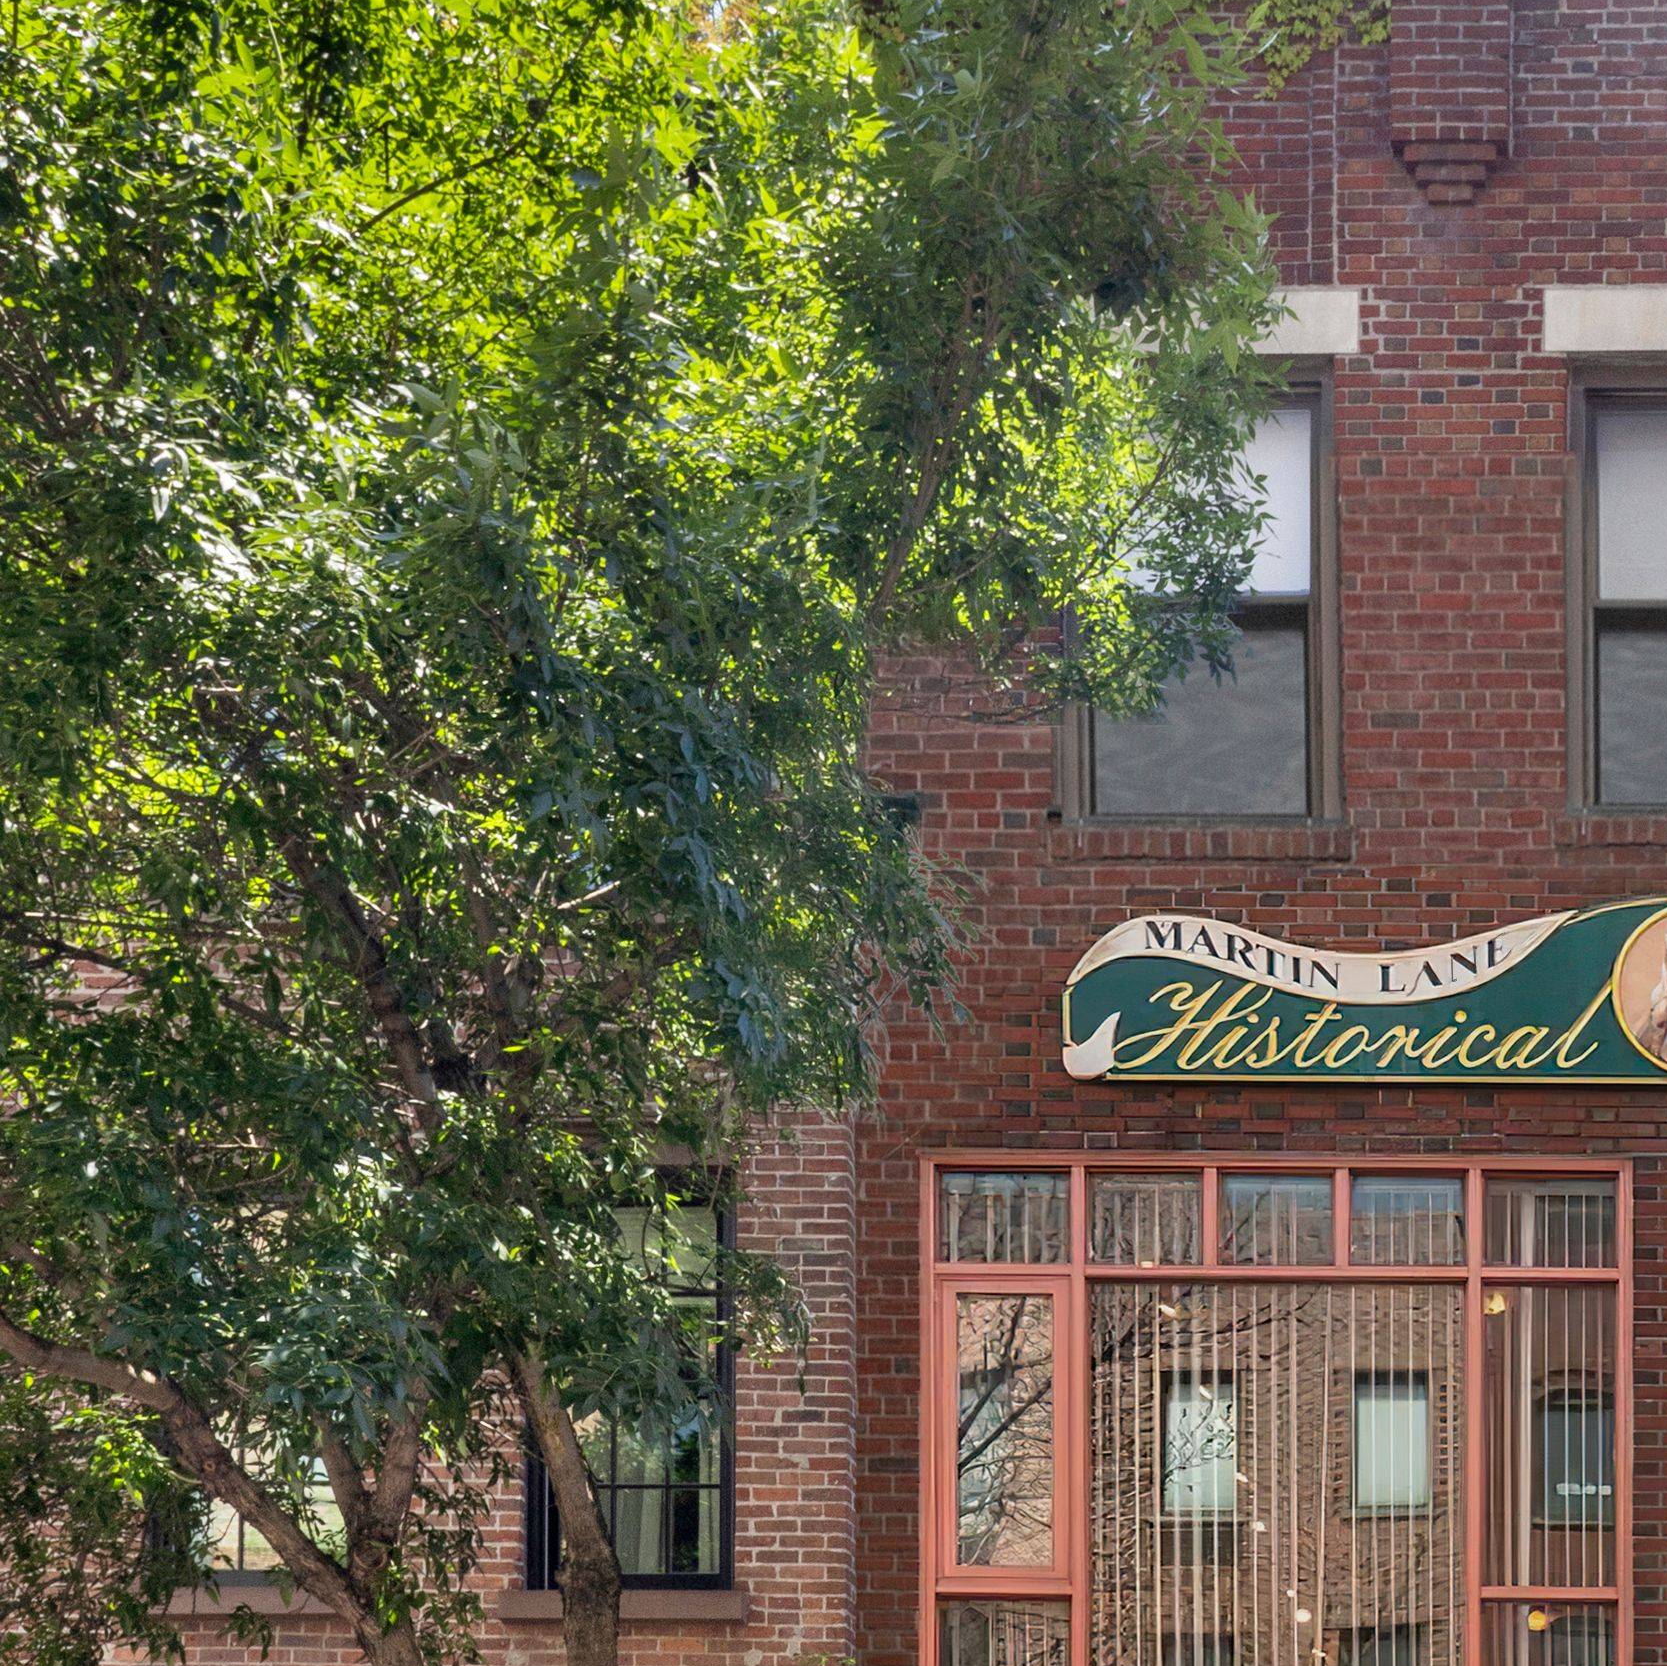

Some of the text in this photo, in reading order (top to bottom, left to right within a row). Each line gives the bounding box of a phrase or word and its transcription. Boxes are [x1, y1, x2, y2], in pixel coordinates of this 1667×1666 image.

[1144, 919, 1341, 991] MARTIN
[1379, 935, 1512, 997] LANE
[1112, 979, 1611, 1071] Historical
